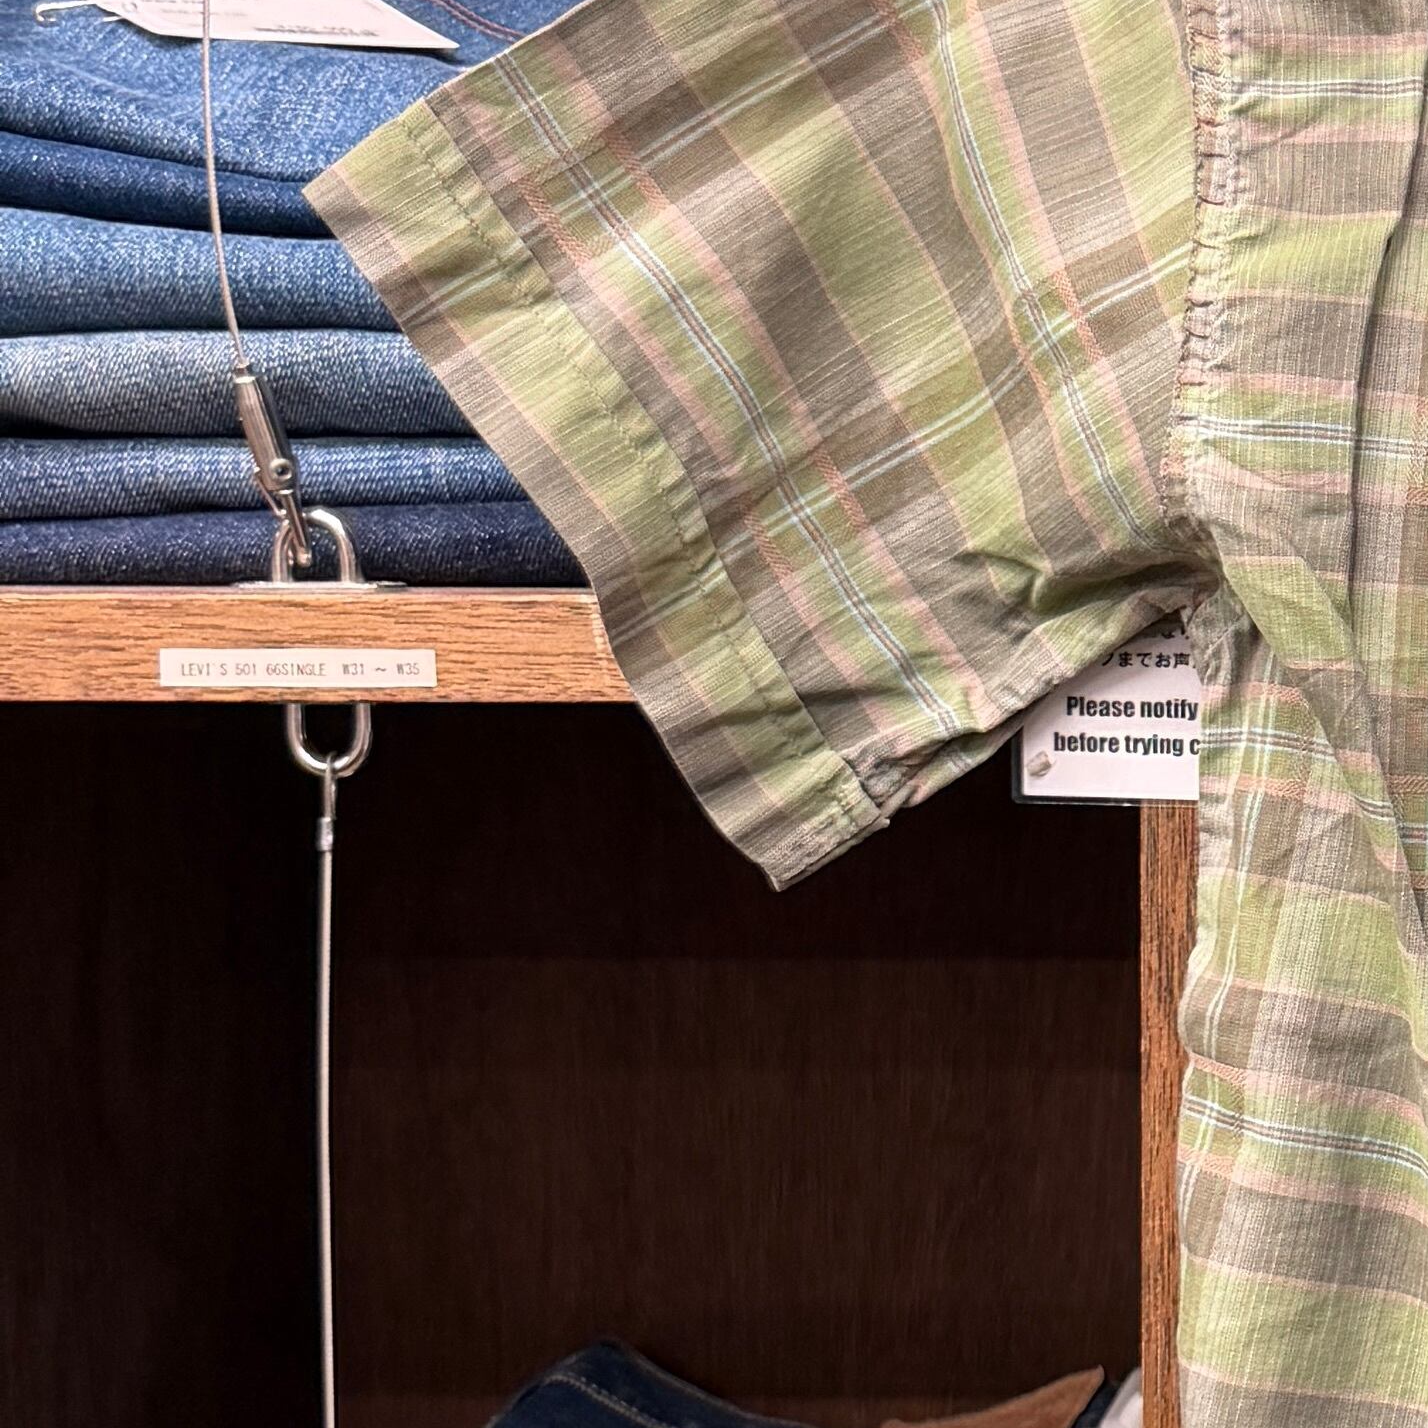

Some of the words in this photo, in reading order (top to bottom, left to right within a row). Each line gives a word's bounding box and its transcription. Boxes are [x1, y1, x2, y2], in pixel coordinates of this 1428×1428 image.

[236, 663, 256, 675] 501
[1066, 695, 1135, 717] Please
[1141, 699, 1198, 720] notify
[1054, 732, 1119, 753] before
[1125, 734, 1183, 756] trying
